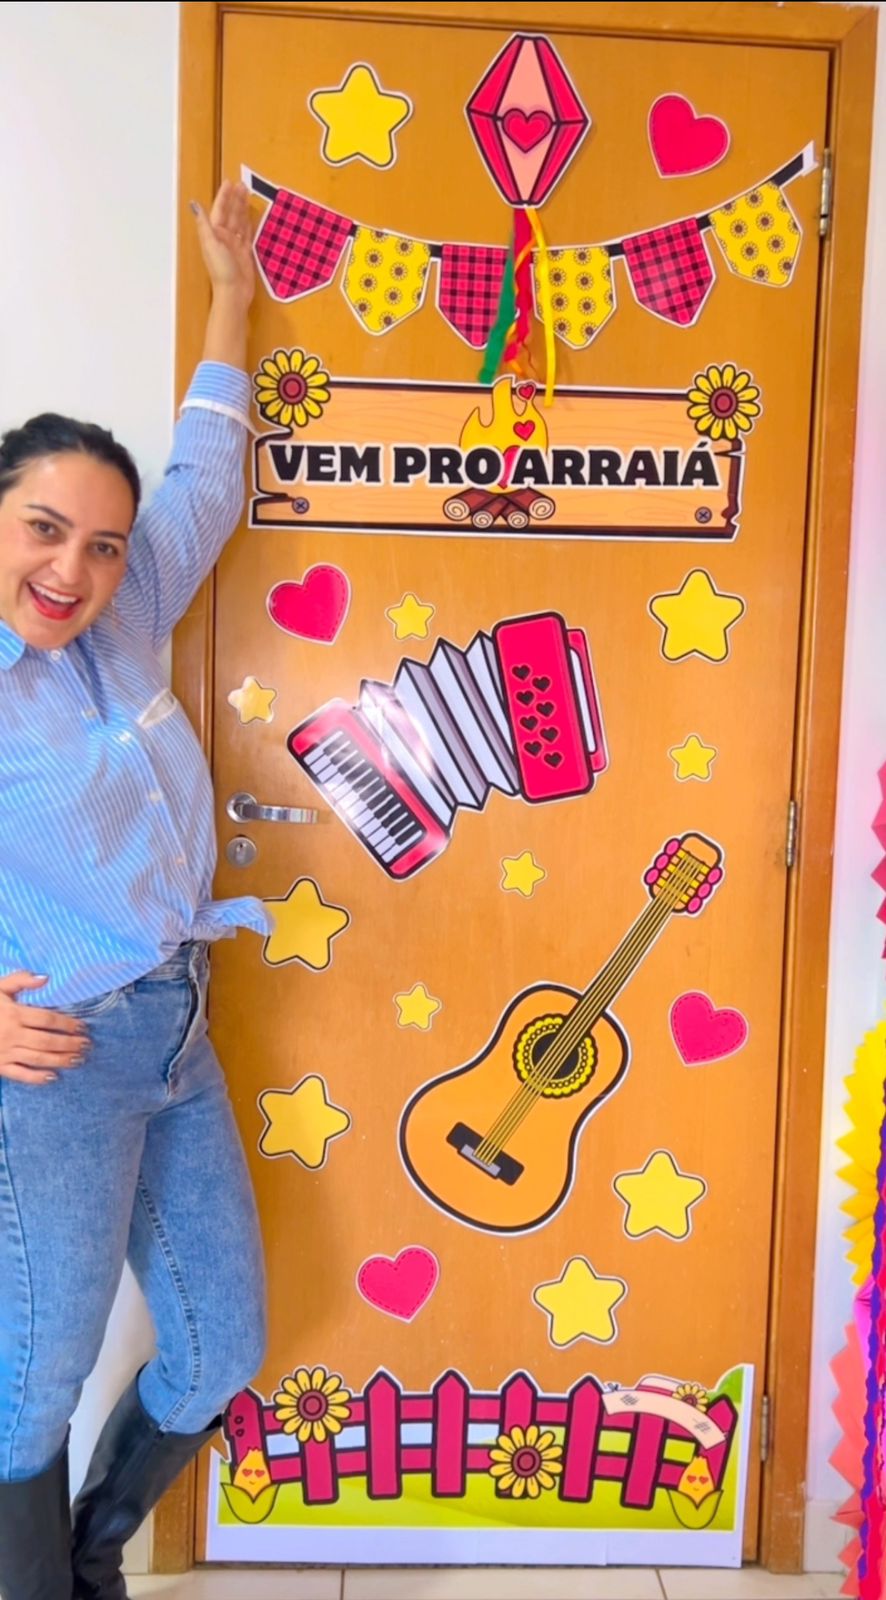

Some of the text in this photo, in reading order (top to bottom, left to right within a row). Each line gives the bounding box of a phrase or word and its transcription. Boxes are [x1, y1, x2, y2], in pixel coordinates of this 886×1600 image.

[269, 441, 719, 486] VEM PRO ARRAIÁ
